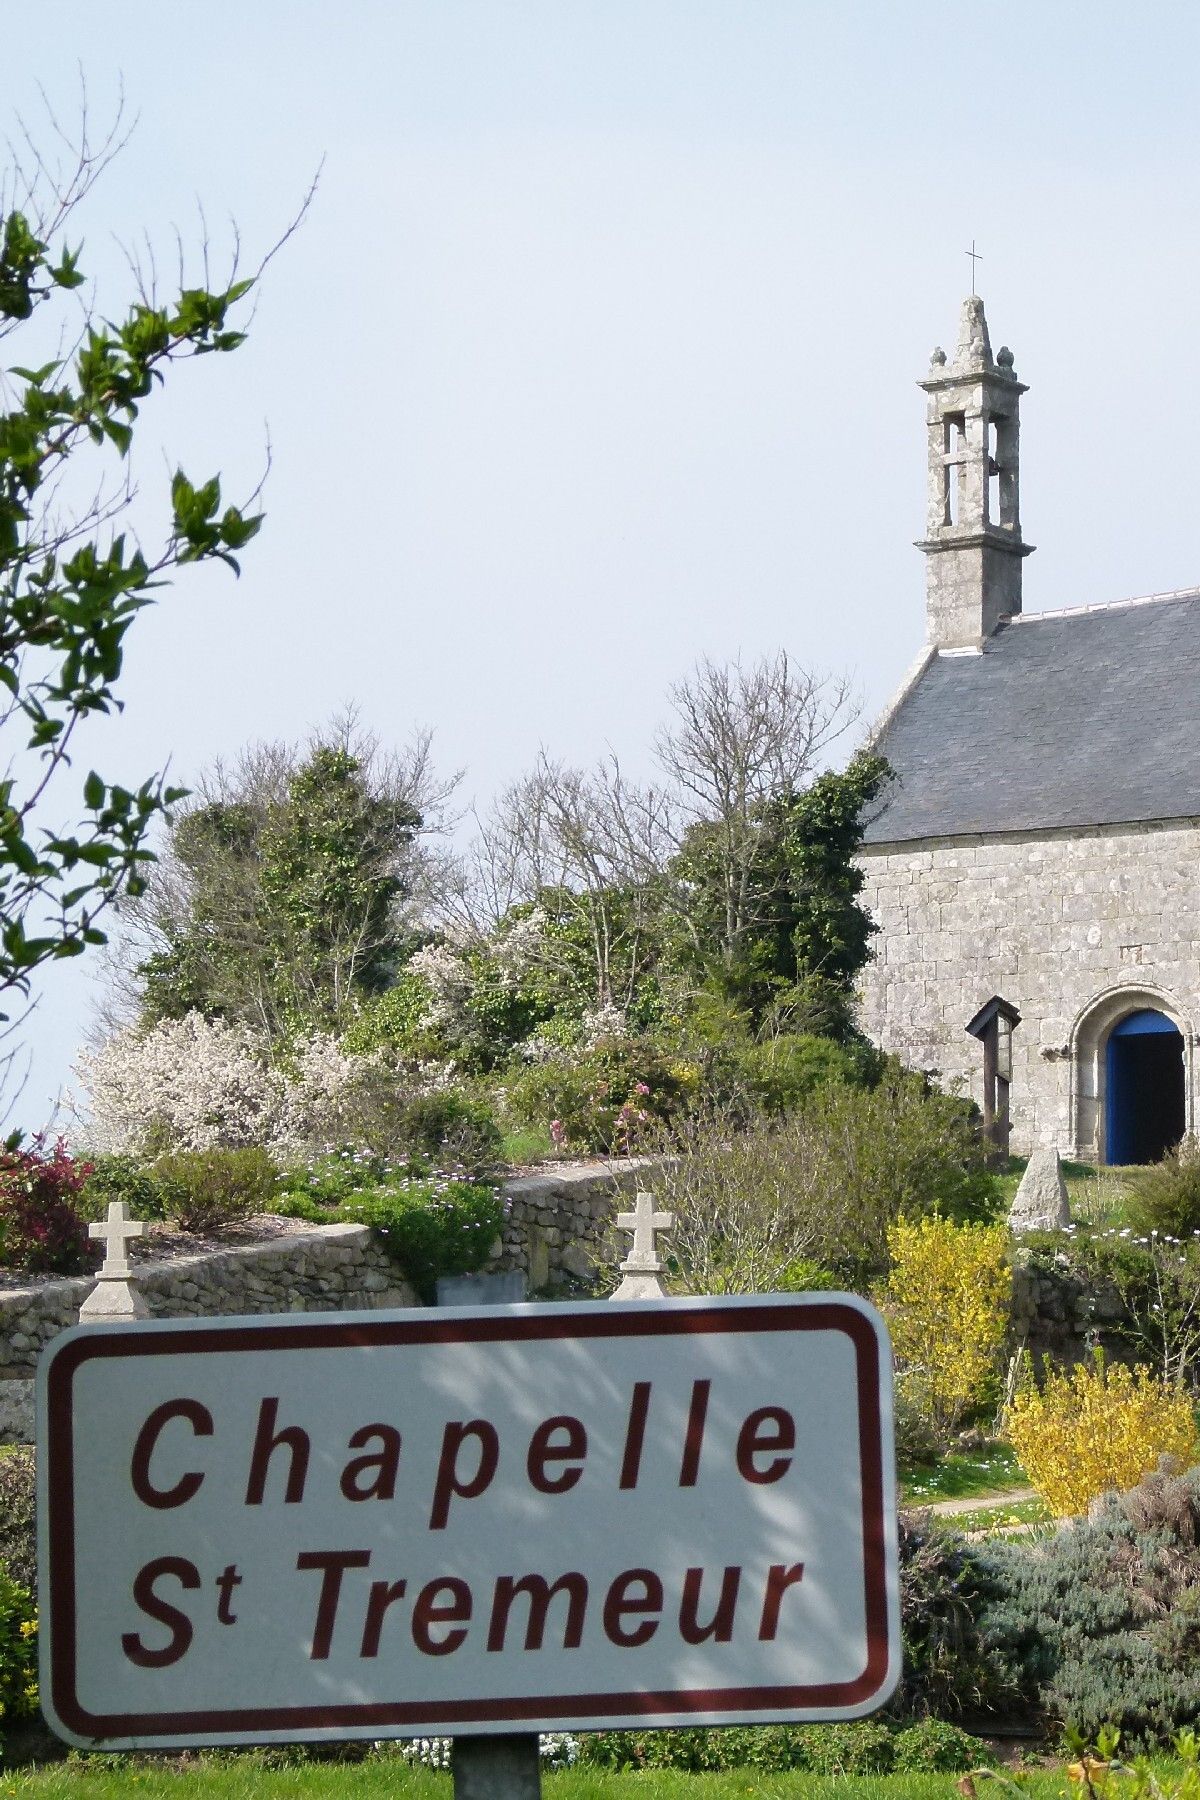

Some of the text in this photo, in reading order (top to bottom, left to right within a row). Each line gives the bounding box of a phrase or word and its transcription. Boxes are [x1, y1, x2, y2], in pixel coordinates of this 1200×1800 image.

[130, 1379, 797, 1531] Chapelle
[121, 1549, 804, 1669] St Tremeur
